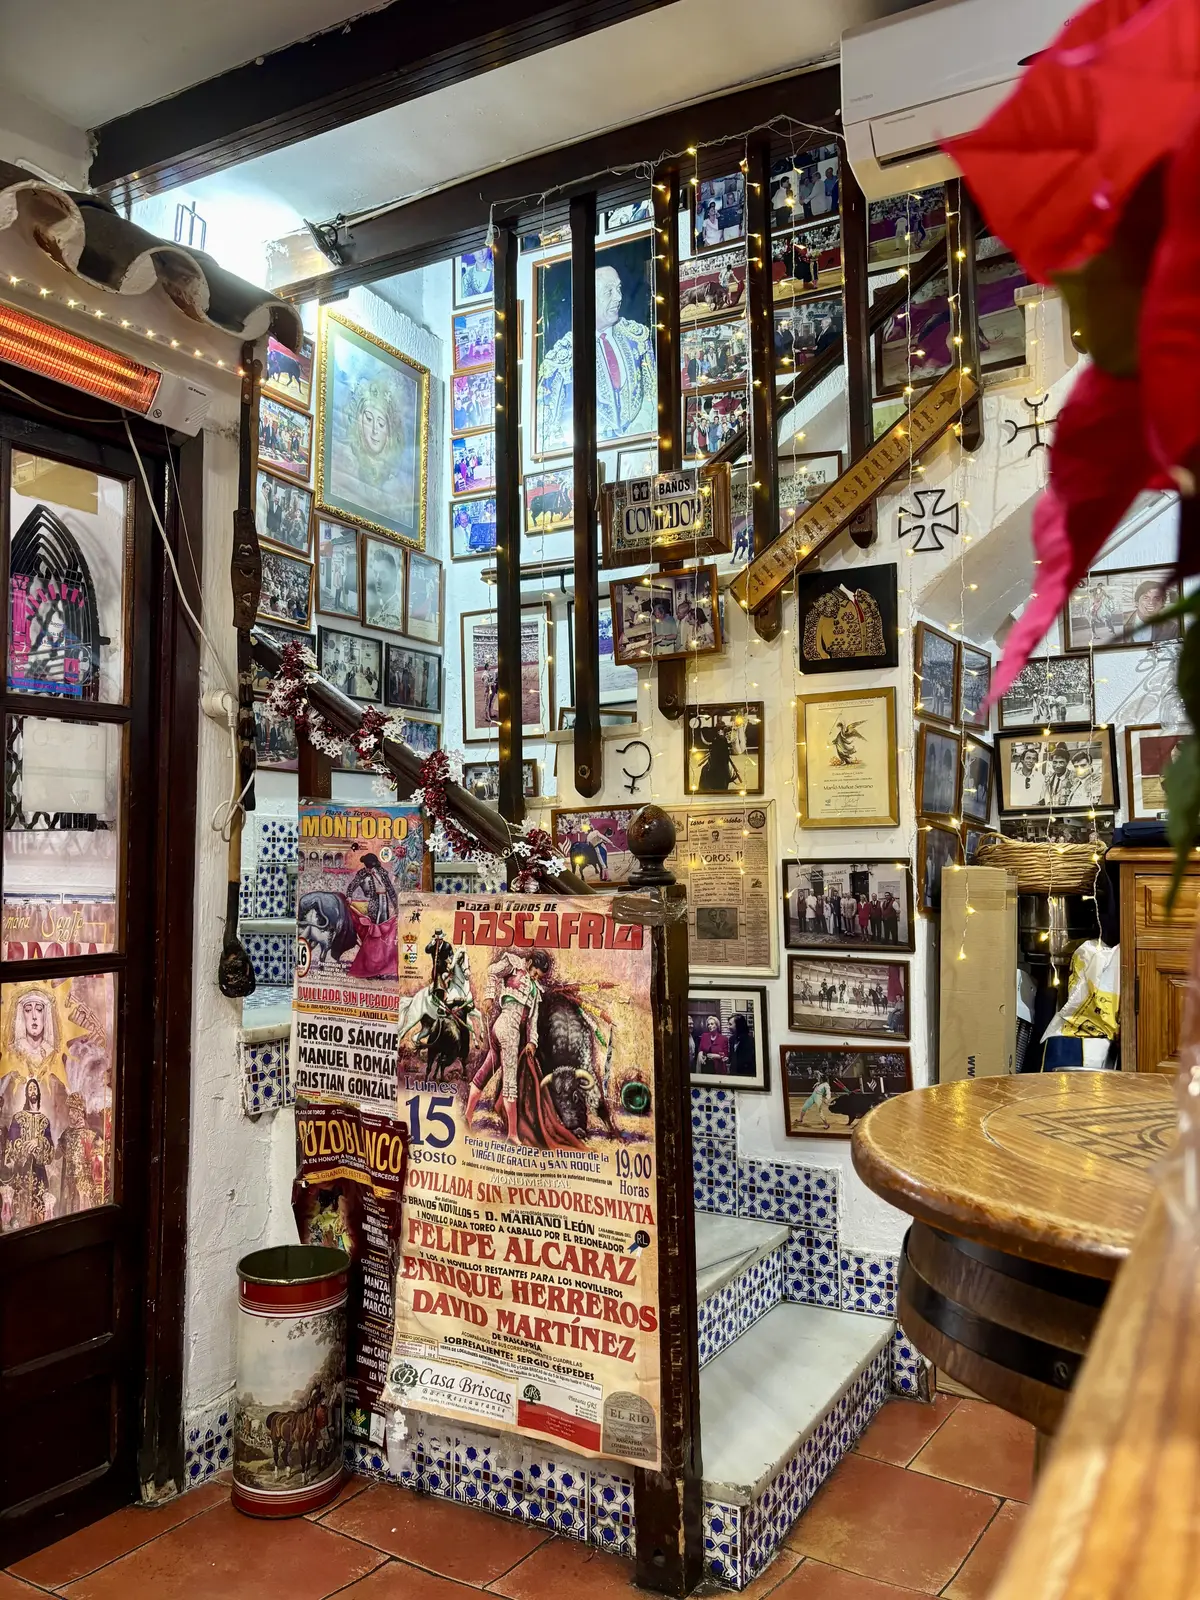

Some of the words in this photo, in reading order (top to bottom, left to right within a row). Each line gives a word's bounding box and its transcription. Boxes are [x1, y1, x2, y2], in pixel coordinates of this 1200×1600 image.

[658, 478, 691, 495] BAÑOS
[301, 815, 409, 841] MONTORO
[543, 904, 558, 912] DE
[41, 907, 84, 938] Santa
[343, 990, 358, 1006] SIN
[358, 1011, 389, 1021] JANDILLA
[298, 1045, 350, 1068] MANUEL
[404, 1075, 458, 1095] Lunes
[405, 1094, 456, 1149] 15
[320, 1155, 340, 1163] HONOR
[464, 1135, 483, 1147] Feria
[484, 1140, 490, 1151] y
[491, 1140, 515, 1154] Fiestas
[516, 1145, 540, 1157] 2022
[542, 1149, 555, 1158] en
[556, 1149, 585, 1160] Honor
[588, 1151, 599, 1161] de
[601, 1152, 610, 1163] la
[472, 1148, 496, 1162] VIRGEN
[497, 1153, 506, 1164] DE
[506, 1155, 538, 1169] GRACIA
[540, 1161, 546, 1171] y
[548, 1160, 568, 1170] SAN
[570, 1161, 601, 1174] ROQUE
[615, 1148, 653, 1180] 19,00
[320, 1168, 348, 1179] GRANDES
[489, 1174, 572, 1190] MONUMENTAL
[476, 1182, 504, 1204] SIN
[619, 1180, 650, 1199] Horas
[408, 1195, 437, 1210] BRAVOS
[439, 1201, 472, 1219] NOVILLOS
[485, 1211, 498, 1222] D.
[500, 1212, 561, 1229] MARIANO
[564, 1219, 595, 1236] LEÓN
[422, 1211, 448, 1224] NOVILLO
[450, 1218, 468, 1230] PARA
[470, 1222, 496, 1232] TOREO
[498, 1225, 505, 1233] A
[507, 1225, 542, 1237] CABALLO
[544, 1229, 560, 1241] POR
[563, 1232, 572, 1243] EL
[574, 1235, 625, 1254] REJONEADOR
[636, 1234, 648, 1246] RL
[407, 1217, 496, 1260] FELIPE
[503, 1236, 638, 1287] ALCARAZ
[426, 1252, 438, 1262] LOS
[447, 1258, 482, 1272] NOVILLOS
[485, 1265, 528, 1280] RESTANTES
[530, 1272, 555, 1284] PARA
[558, 1277, 573, 1286] LOS
[575, 1281, 623, 1299] NOVILLEROS
[363, 1288, 379, 1301] PABLO
[400, 1255, 504, 1300] ENRIQUE
[511, 1279, 659, 1333] HERREROS
[362, 1298, 388, 1316] MARCO
[412, 1289, 489, 1328] DAVID
[496, 1308, 637, 1364] MARTÍNEZ
[362, 1344, 373, 1356] ANDY
[492, 1332, 501, 1341] DE
[503, 1335, 543, 1352] RASCAFRÍA
[356, 1354, 378, 1369] LEONARDO
[443, 1336, 514, 1360] SOBRESALIENTE:
[517, 1354, 550, 1369] SERGIO
[552, 1364, 595, 1381] CÉSPEDES
[507, 1343, 552, 1362] CORRESPONDIENTES
[553, 1357, 583, 1368] CUADRILLAS
[369, 1371, 377, 1381] LEA
[419, 1367, 456, 1390] Casa
[459, 1376, 512, 1405] Briscas
[609, 1408, 625, 1420] EL
[629, 1411, 650, 1424] RIO
